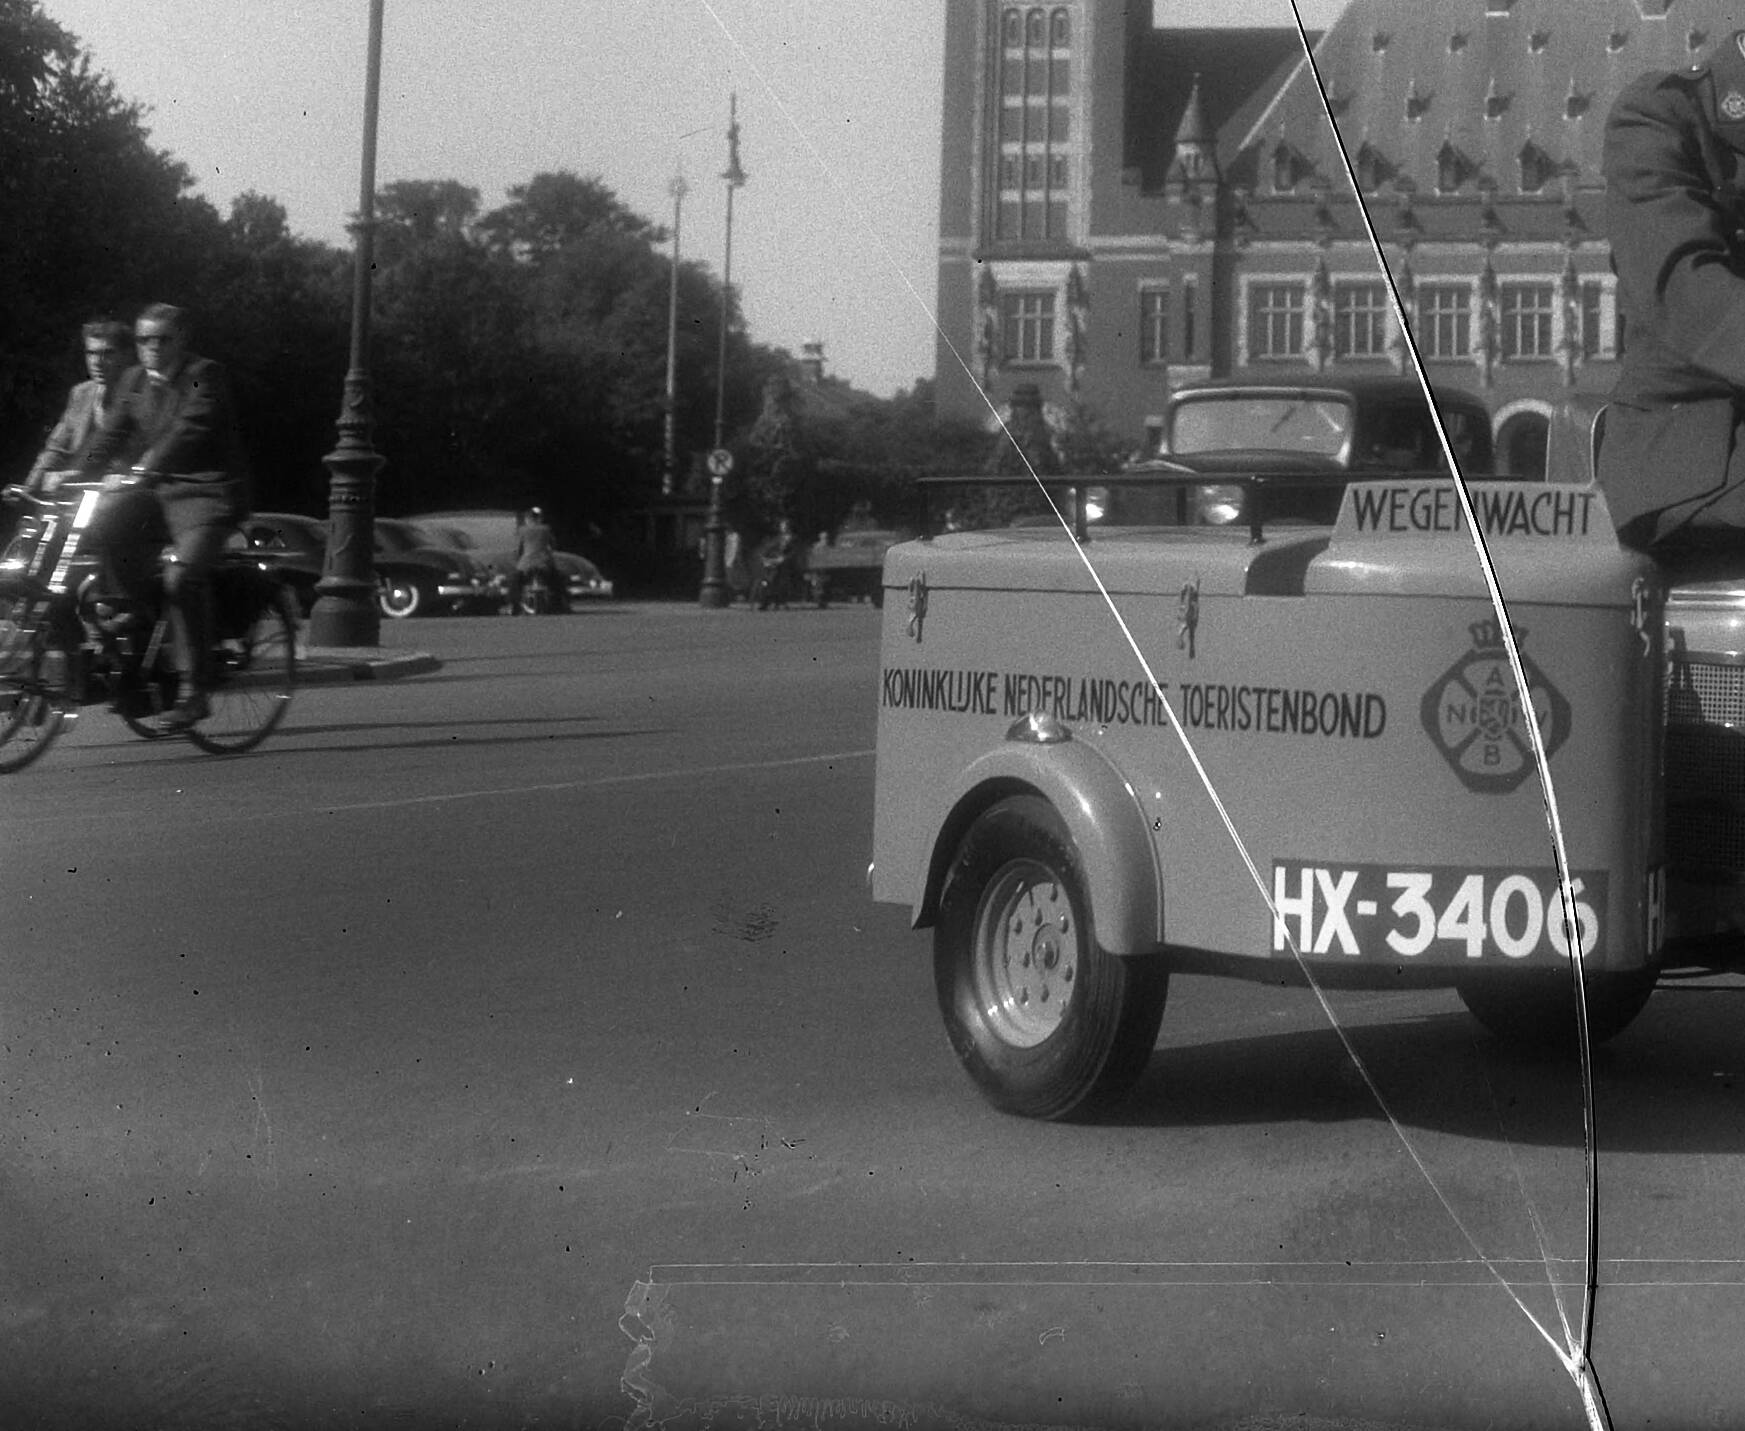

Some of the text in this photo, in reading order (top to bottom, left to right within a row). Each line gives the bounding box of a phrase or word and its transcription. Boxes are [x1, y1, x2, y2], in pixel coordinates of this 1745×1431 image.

[1353, 487, 1596, 536] WEGENWACHT
[882, 668, 1387, 739] KONINKLIJKE NEDERLANDSCHE TOERISTENBOND
[1273, 866, 1599, 958] HX-3406
